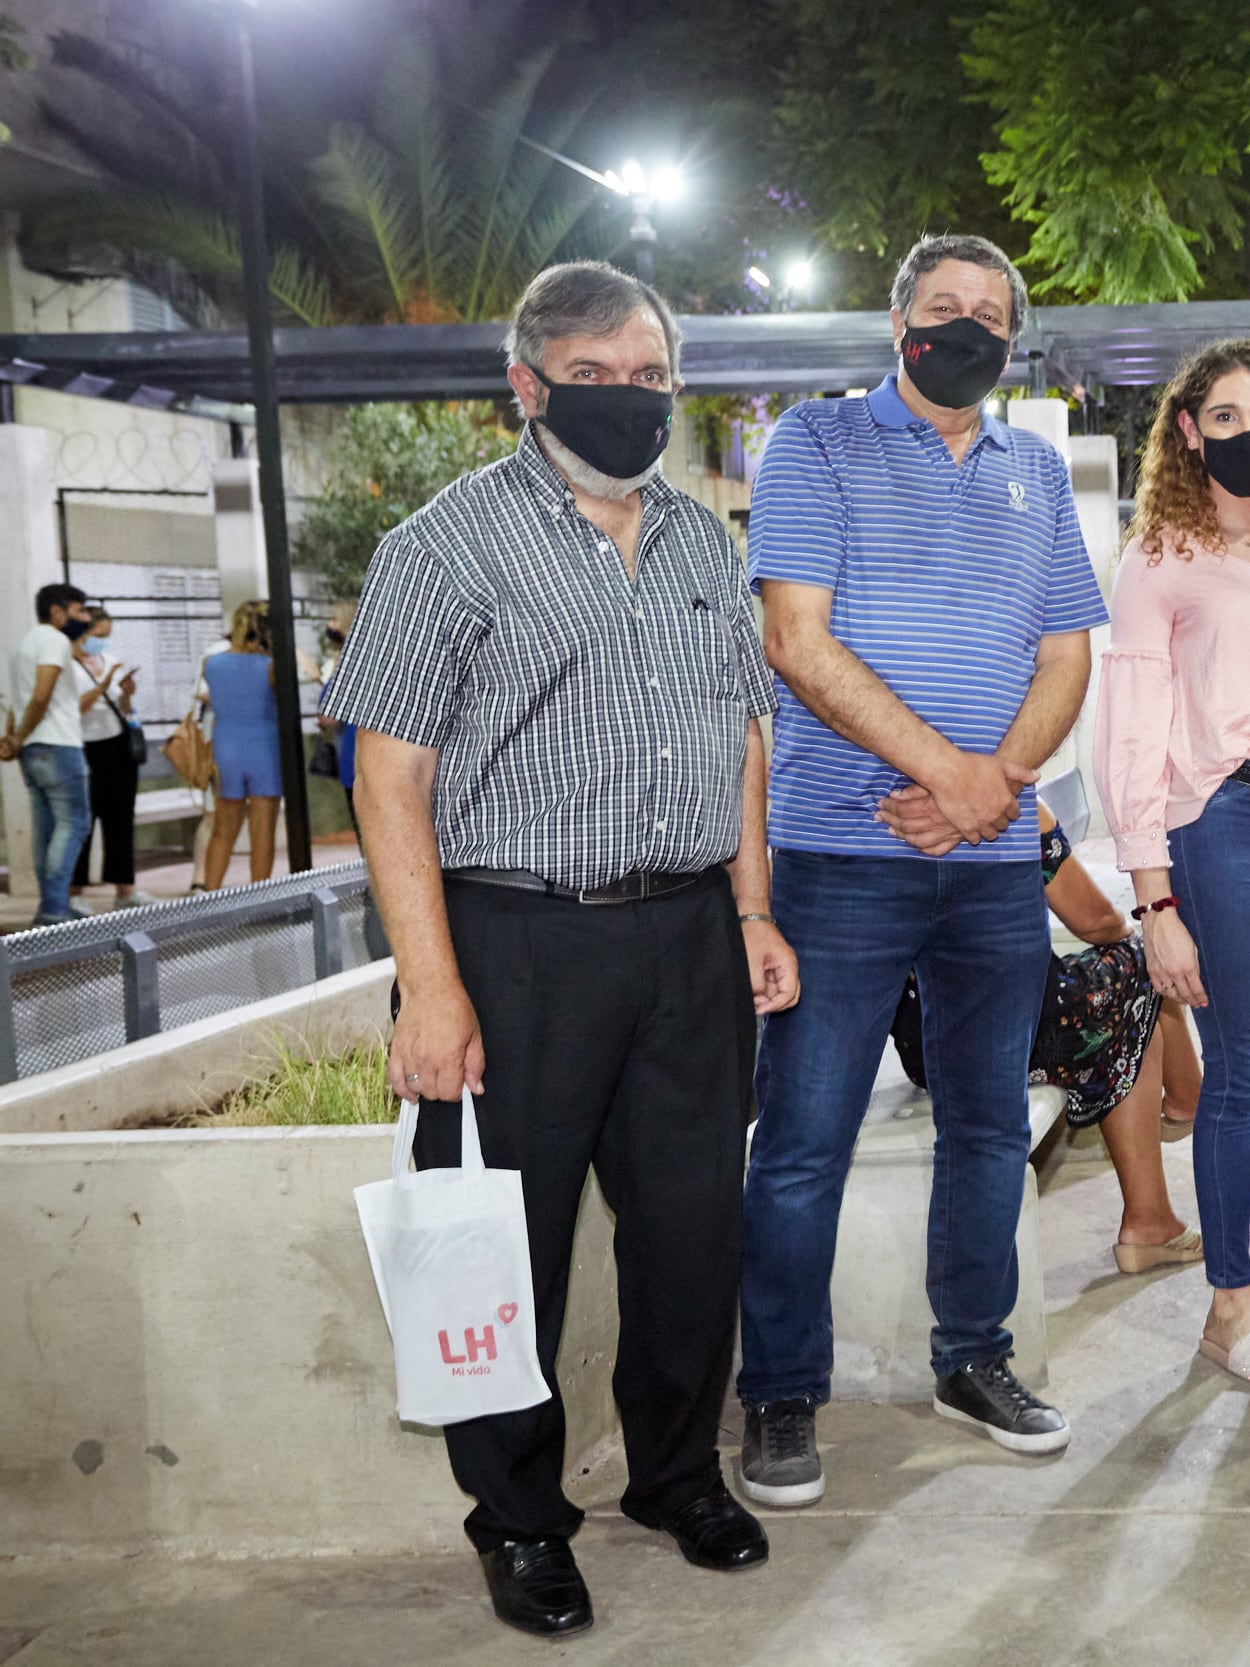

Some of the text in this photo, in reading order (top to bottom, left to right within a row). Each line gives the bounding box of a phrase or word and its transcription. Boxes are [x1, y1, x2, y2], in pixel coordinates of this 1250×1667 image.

[438, 1325, 497, 1363] LH
[452, 1365, 491, 1376] Mi vida
